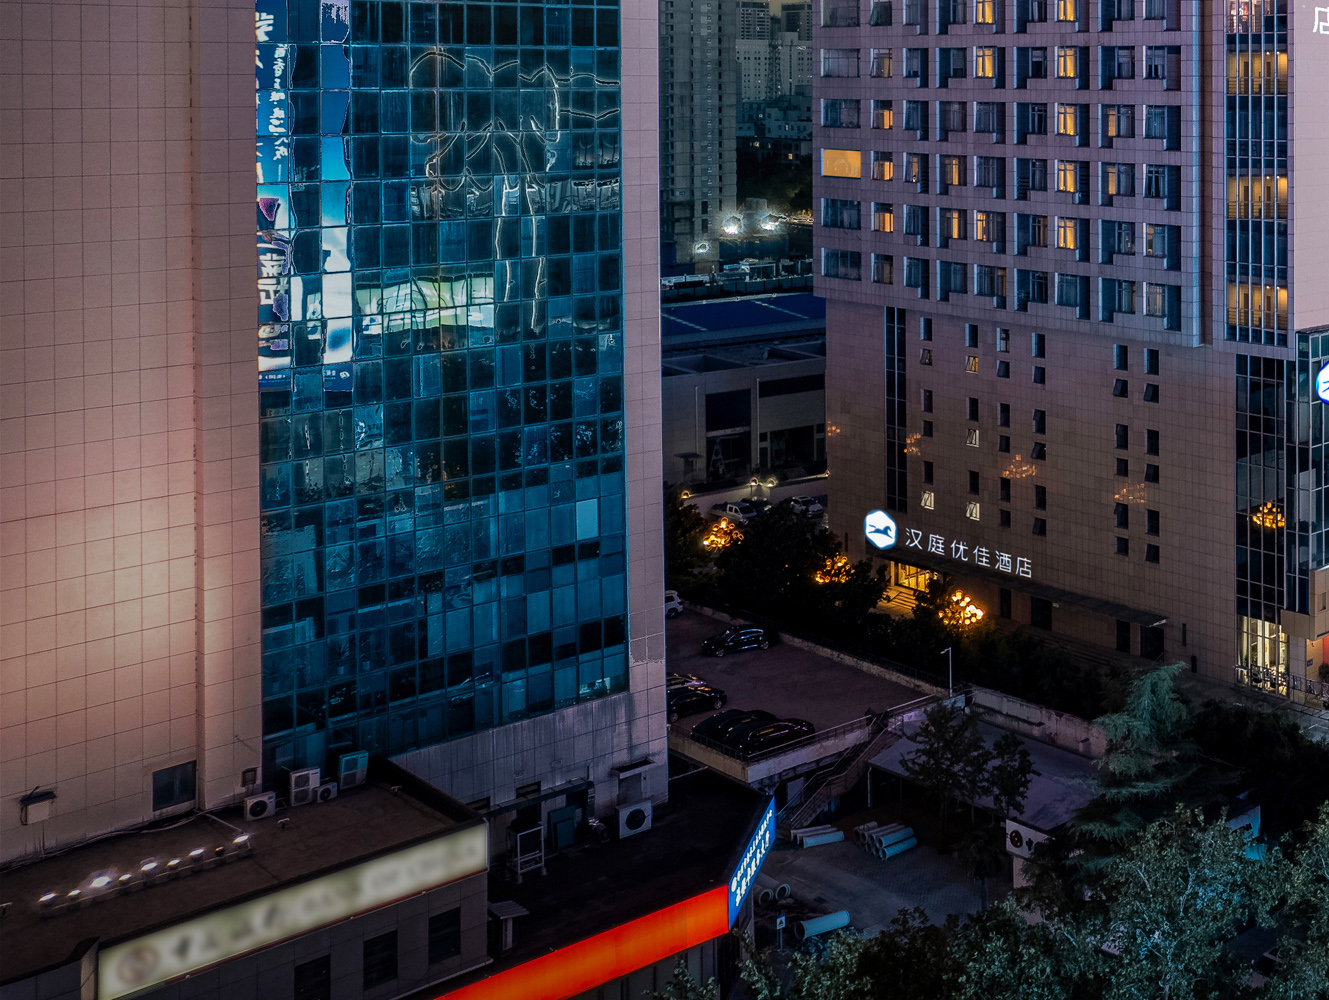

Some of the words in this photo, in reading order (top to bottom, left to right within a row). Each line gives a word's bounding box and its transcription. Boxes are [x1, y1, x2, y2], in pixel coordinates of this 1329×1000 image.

[905, 527, 1032, 579] 汉庭优佳酒店
